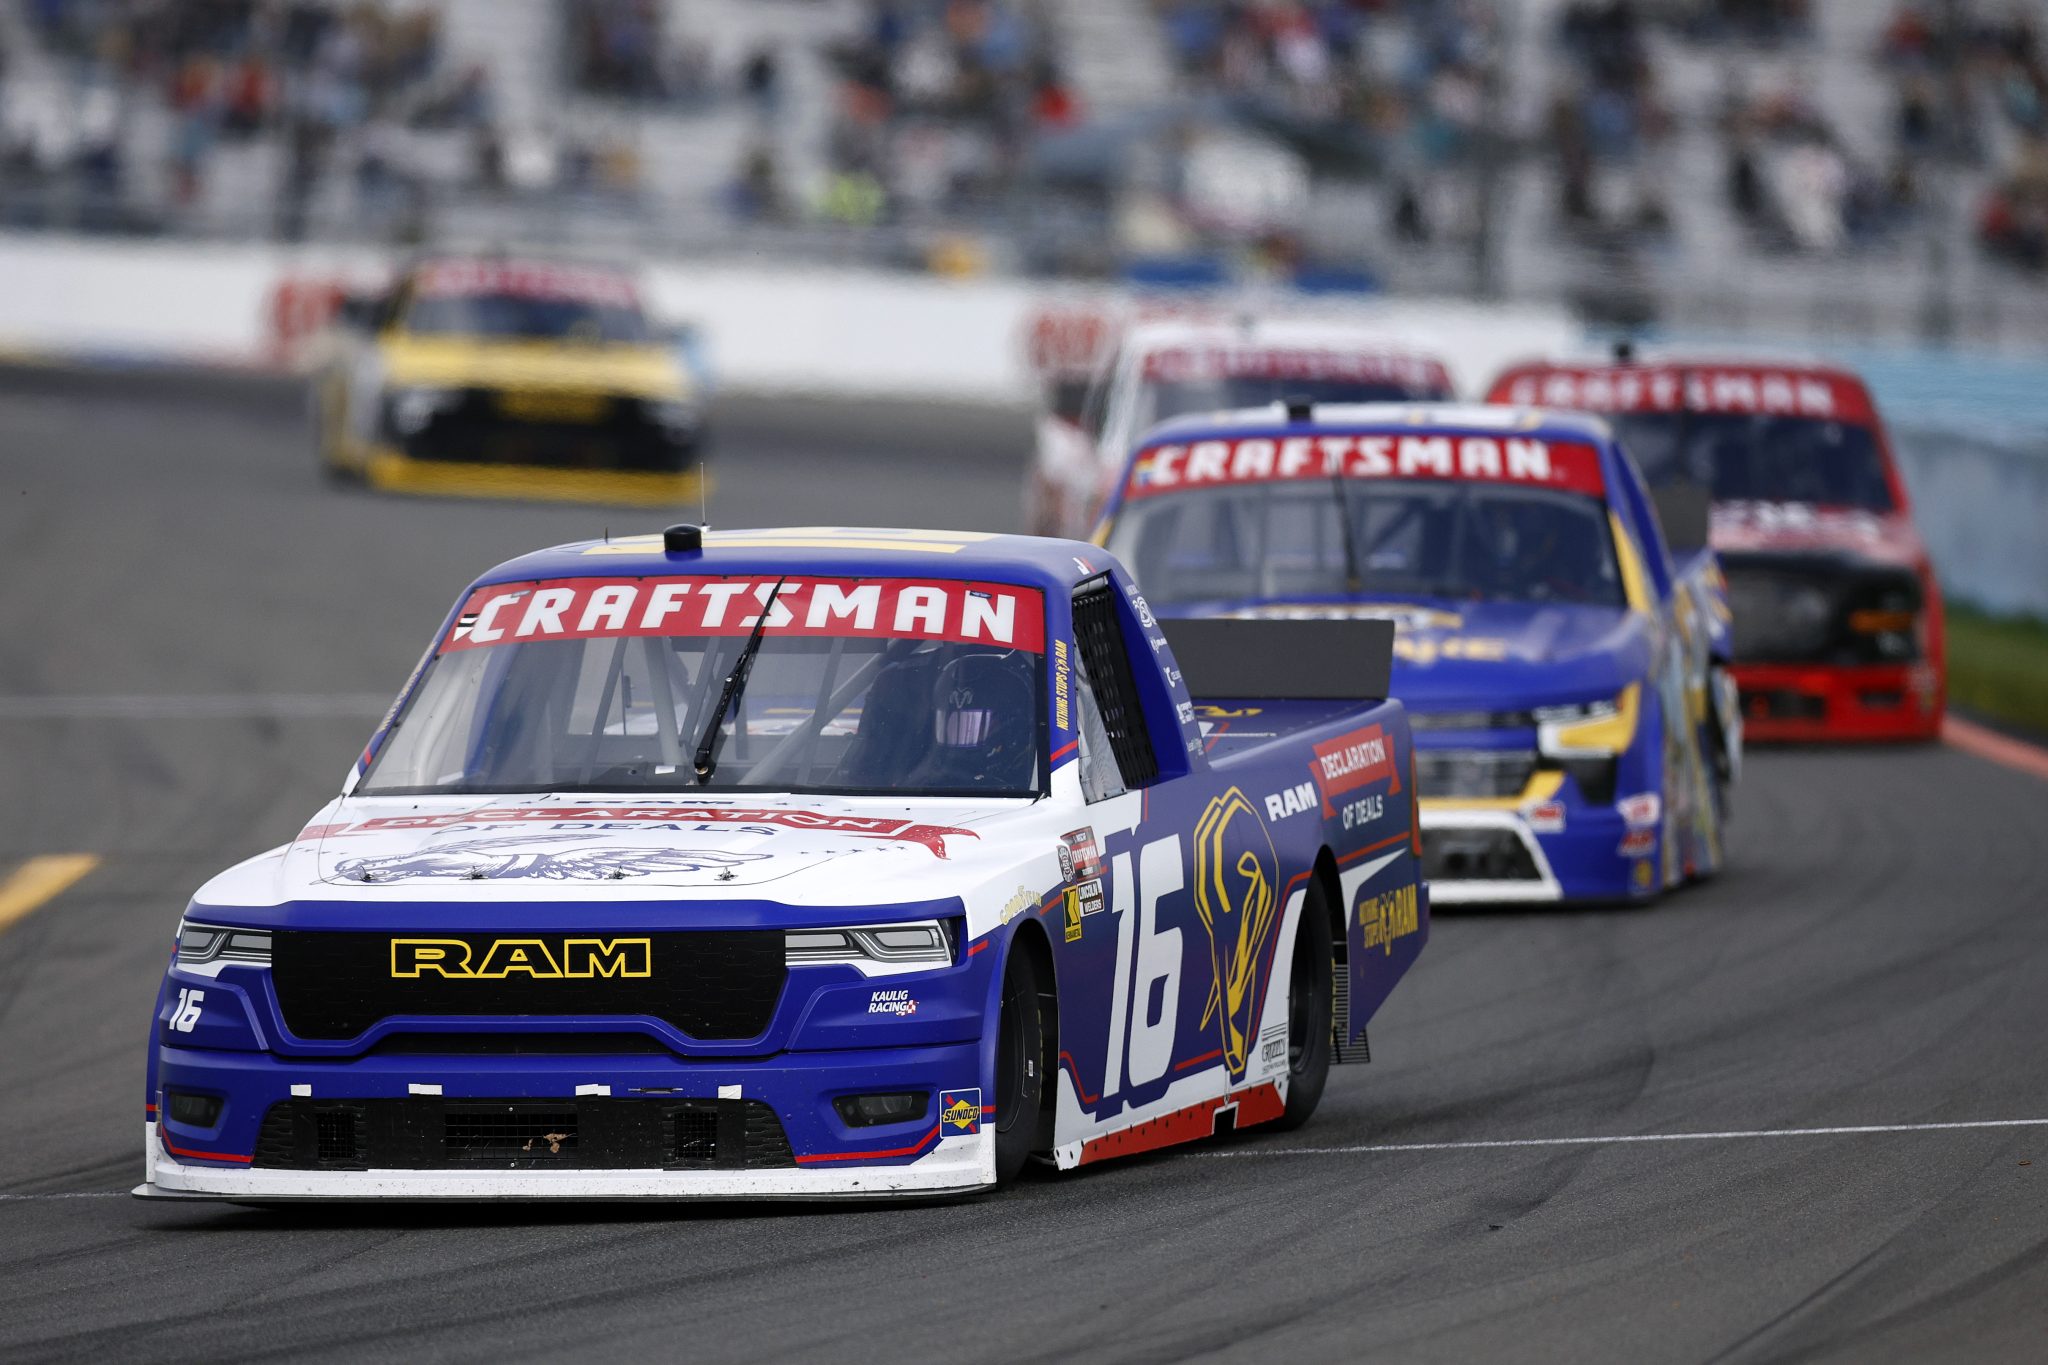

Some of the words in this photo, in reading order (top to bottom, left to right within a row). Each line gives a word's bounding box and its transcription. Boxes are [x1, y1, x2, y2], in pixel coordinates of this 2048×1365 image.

[1149, 437, 1552, 486] CRAFTSMAN
[469, 583, 1016, 643] CRAFTSMAN
[1055, 639, 1068, 660] RAM
[1056, 672, 1068, 699] STOPS
[1056, 697, 1069, 730] NOTHING
[1320, 738, 1386, 780] DECLARATION
[1264, 781, 1318, 822] RAM
[1342, 804, 1355, 830] OF
[1356, 795, 1383, 826] DEALS
[380, 808, 882, 828] DECLARATION
[431, 823, 527, 836] OF
[549, 823, 778, 836] DEALS
[1079, 882, 1099, 901] LINCOLN
[1084, 899, 1102, 913] WELDERS
[391, 938, 651, 978] RAM
[1103, 833, 1184, 1098] 16
[169, 988, 205, 1033] 16
[868, 1000, 908, 1013] RACING
[871, 990, 908, 1002] KAULIG
[943, 1106, 979, 1122] SUNOCO
